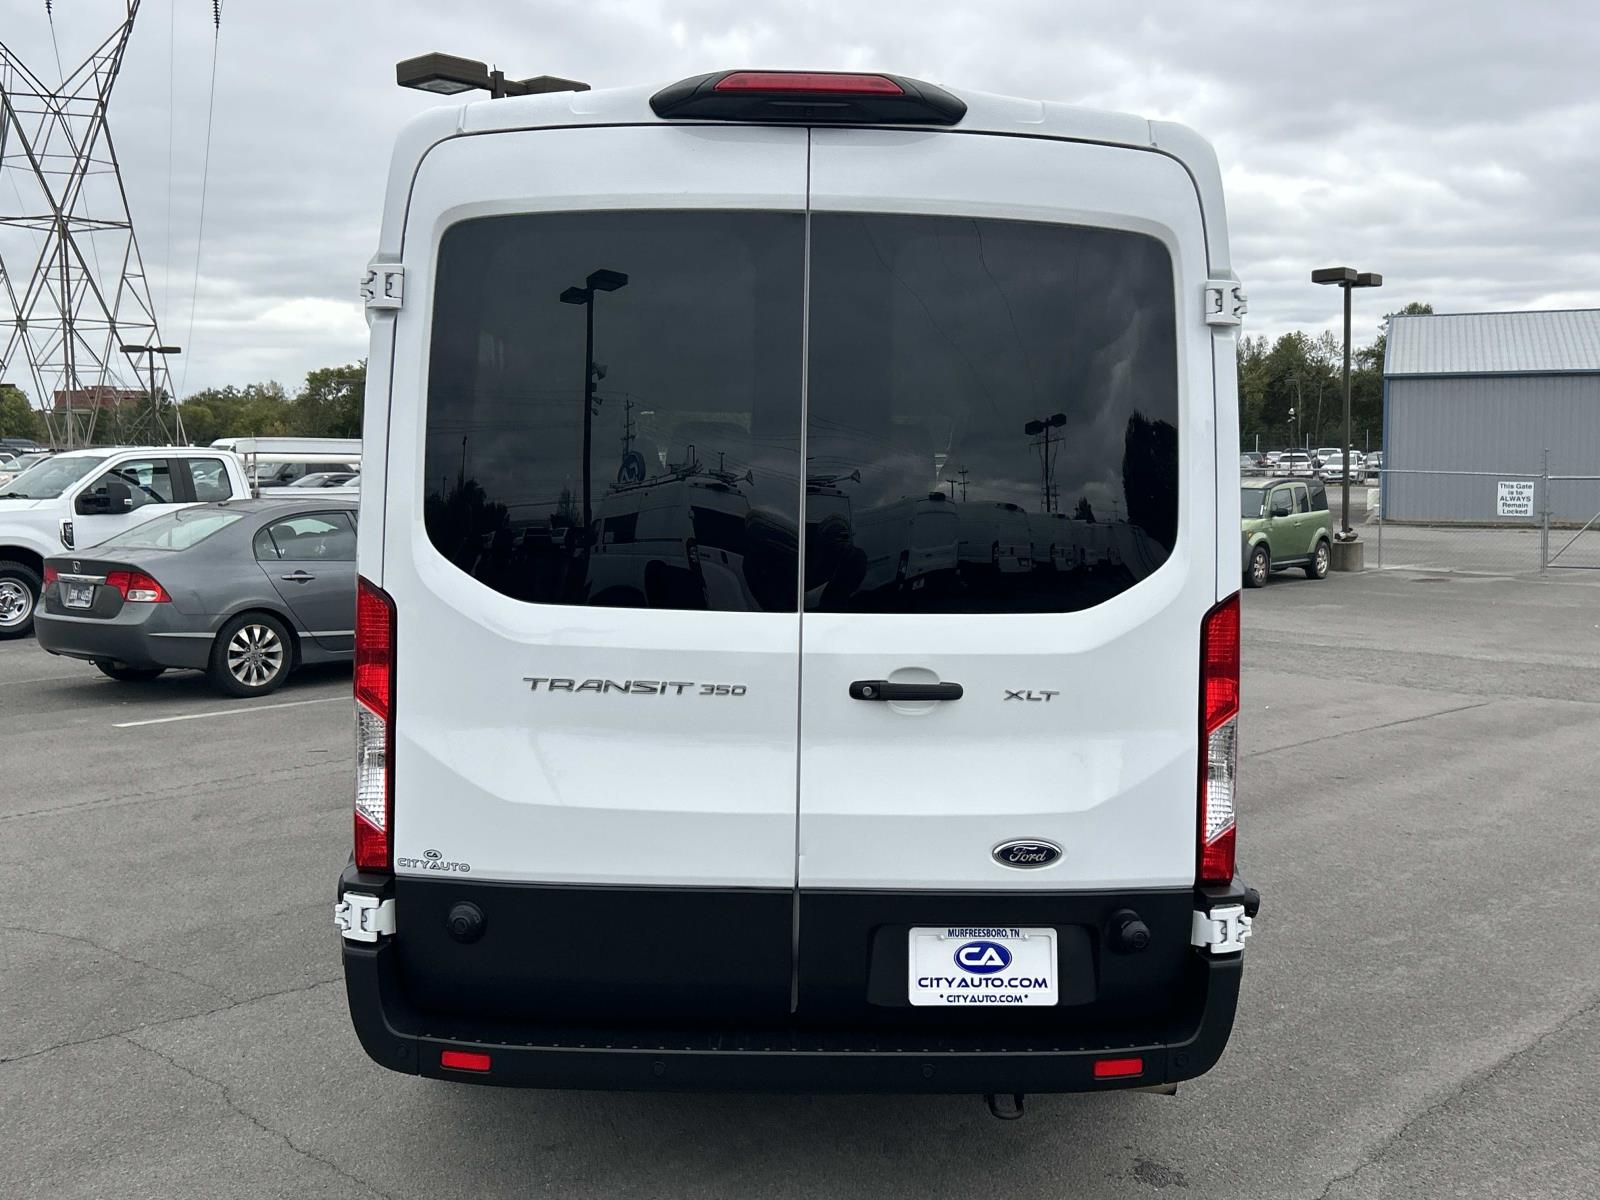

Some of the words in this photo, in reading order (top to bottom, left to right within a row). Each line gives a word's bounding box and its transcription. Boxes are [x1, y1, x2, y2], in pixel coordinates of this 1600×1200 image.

[523, 677, 695, 696] TRANSIT
[699, 684, 747, 696] 350
[1003, 690, 1060, 702] XLT
[1009, 845, 1047, 862] Ford
[947, 928, 1009, 939] MURFREESBORO,
[1010, 928, 1020, 938] TN
[959, 947, 1005, 966] CA
[917, 977, 1048, 989] CITYAUTO.COM
